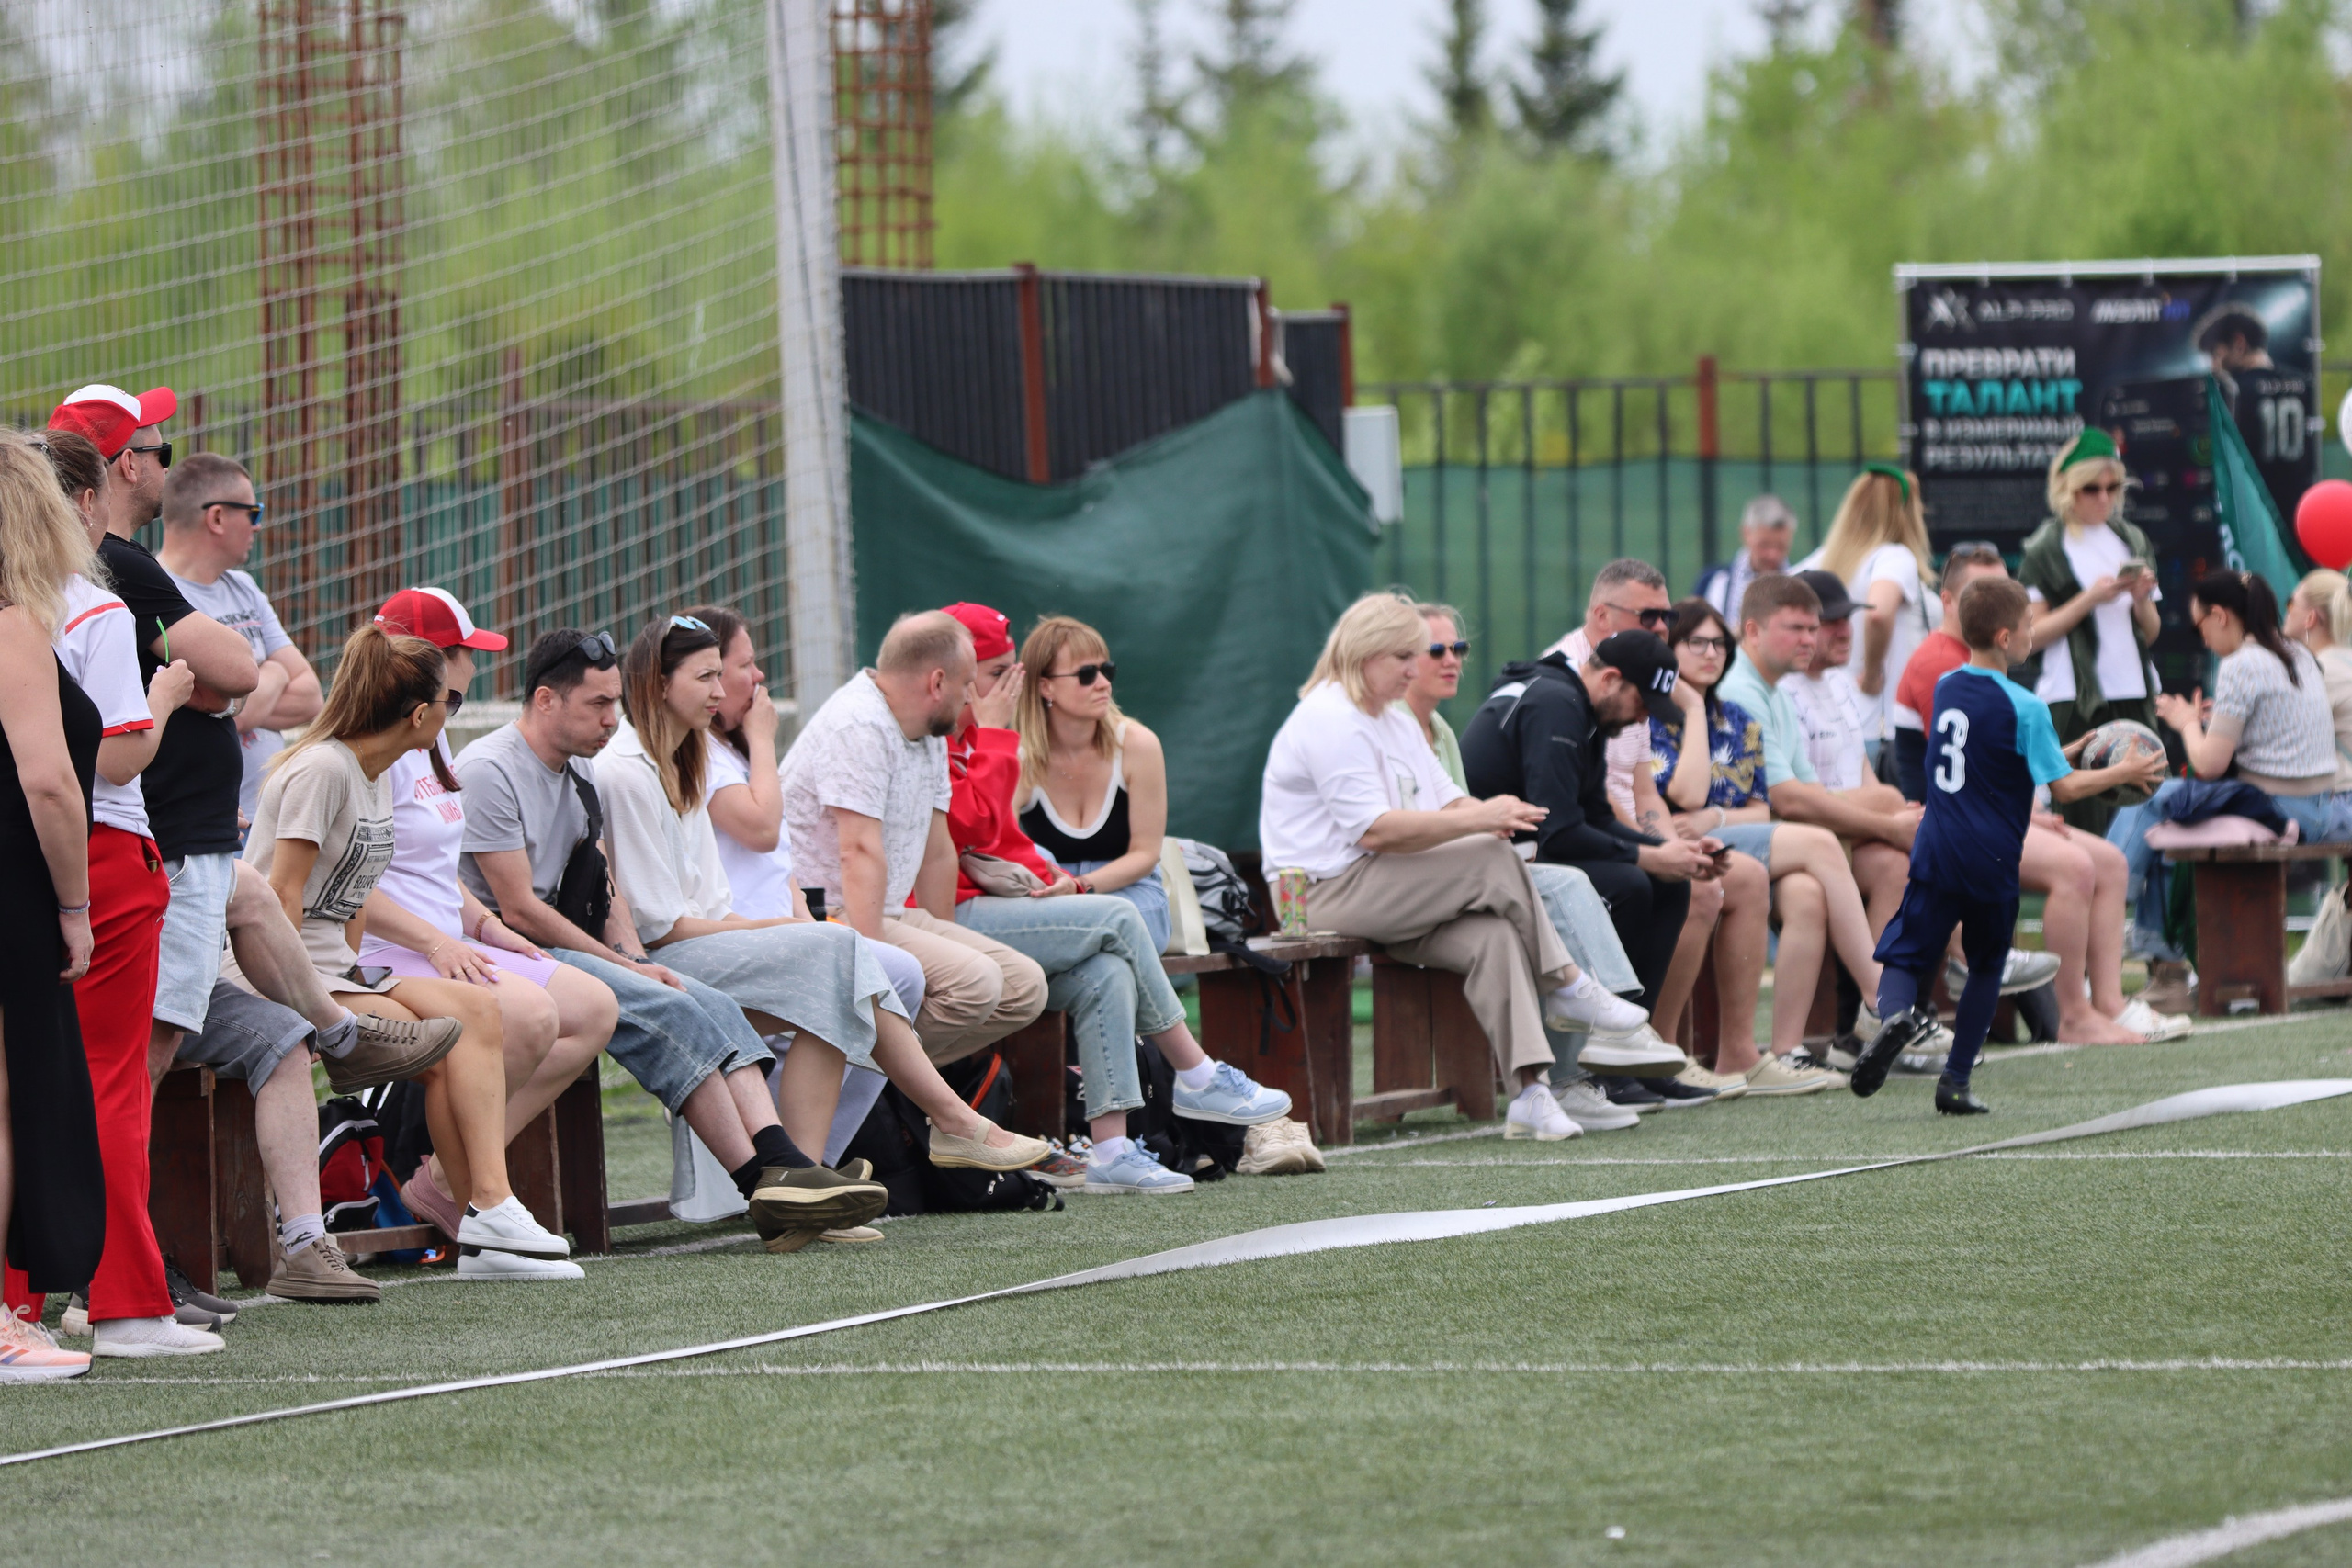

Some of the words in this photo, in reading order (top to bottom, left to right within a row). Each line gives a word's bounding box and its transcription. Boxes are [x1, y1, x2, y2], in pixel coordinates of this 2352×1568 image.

[1921, 347, 2076, 378] ПРЕВРАТИ
[1923, 378, 2083, 416] ТАЛАНТ
[1923, 417, 1942, 443] В
[1944, 413, 2085, 442] ИЗМЕРИМЫЙ
[2259, 396, 2305, 462] 10
[1651, 666, 1679, 694] IC
[1934, 707, 1969, 795] 3
